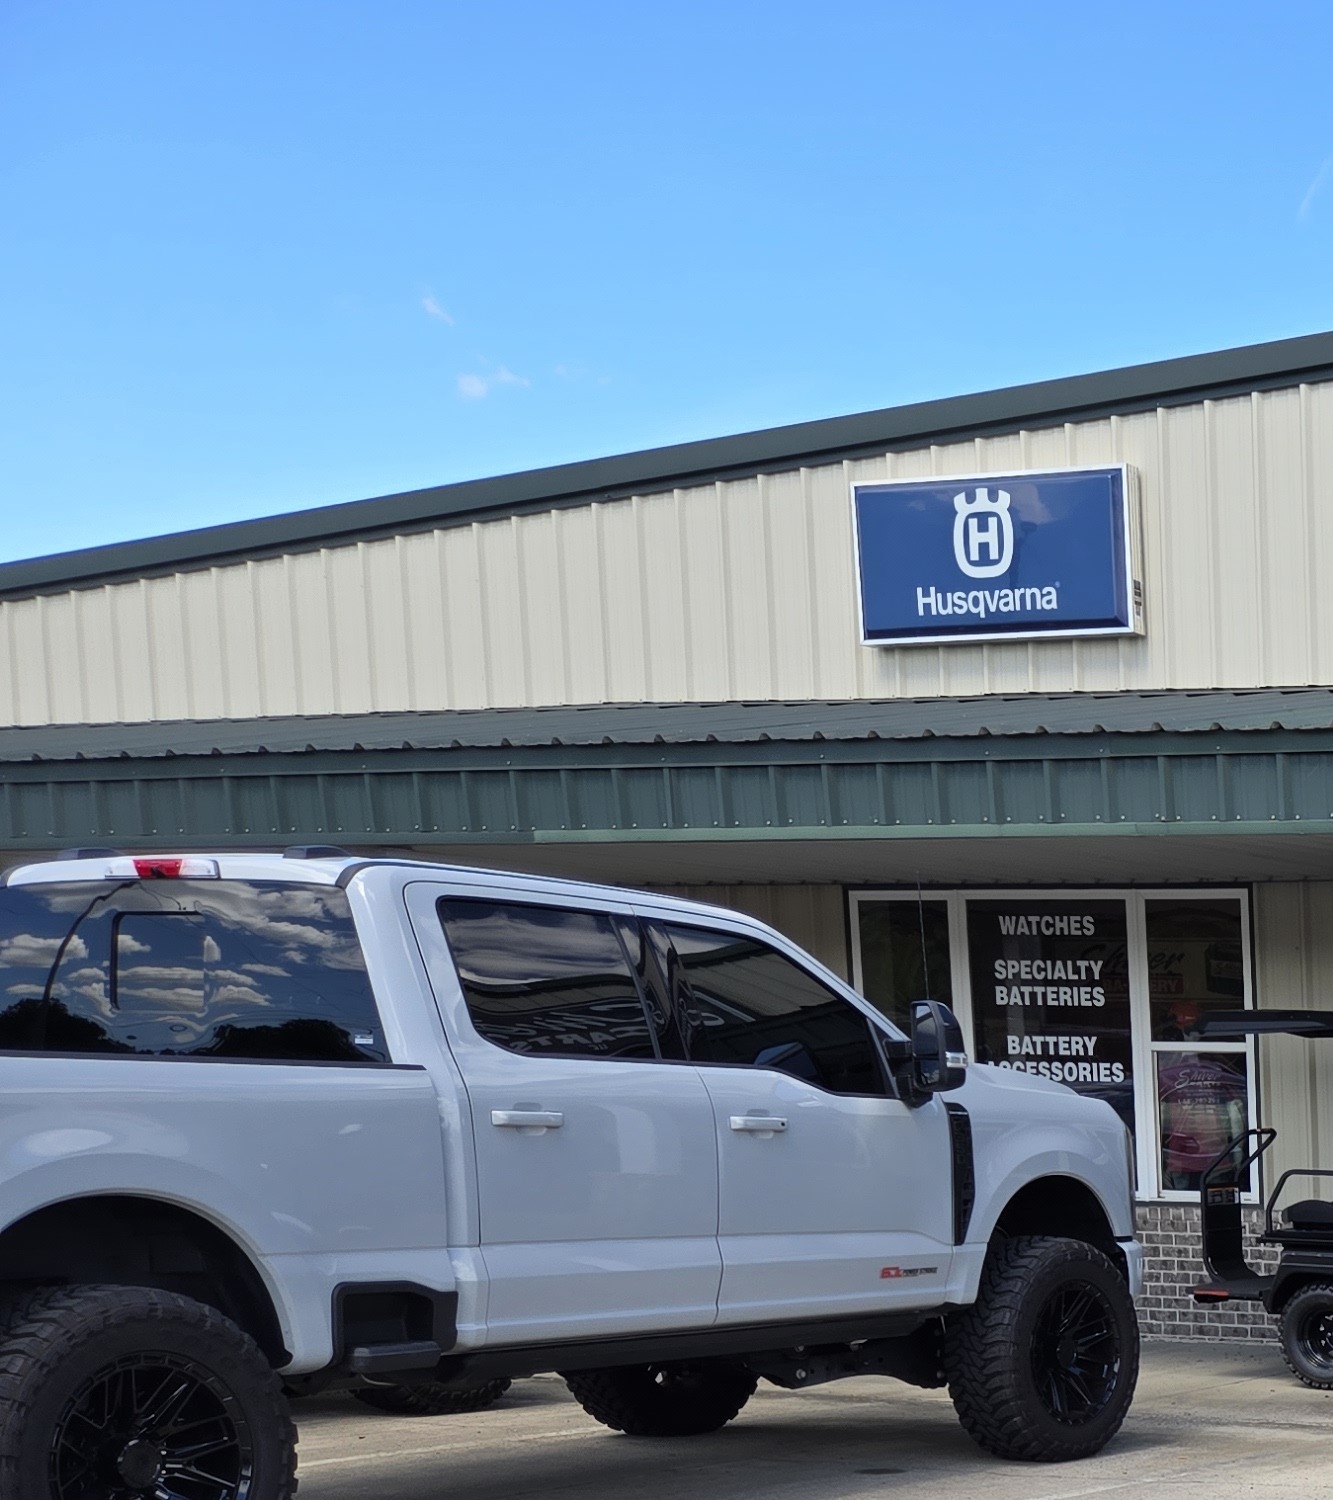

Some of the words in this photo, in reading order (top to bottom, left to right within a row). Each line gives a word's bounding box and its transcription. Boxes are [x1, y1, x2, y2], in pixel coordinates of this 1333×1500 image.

[915, 585, 1058, 617] Husqvarna
[998, 915, 1095, 936] WATCHES
[994, 959, 1103, 981] SPECIALTY
[994, 985, 1106, 1007] BATTERIES
[1007, 1034, 1098, 1057] BATTERY
